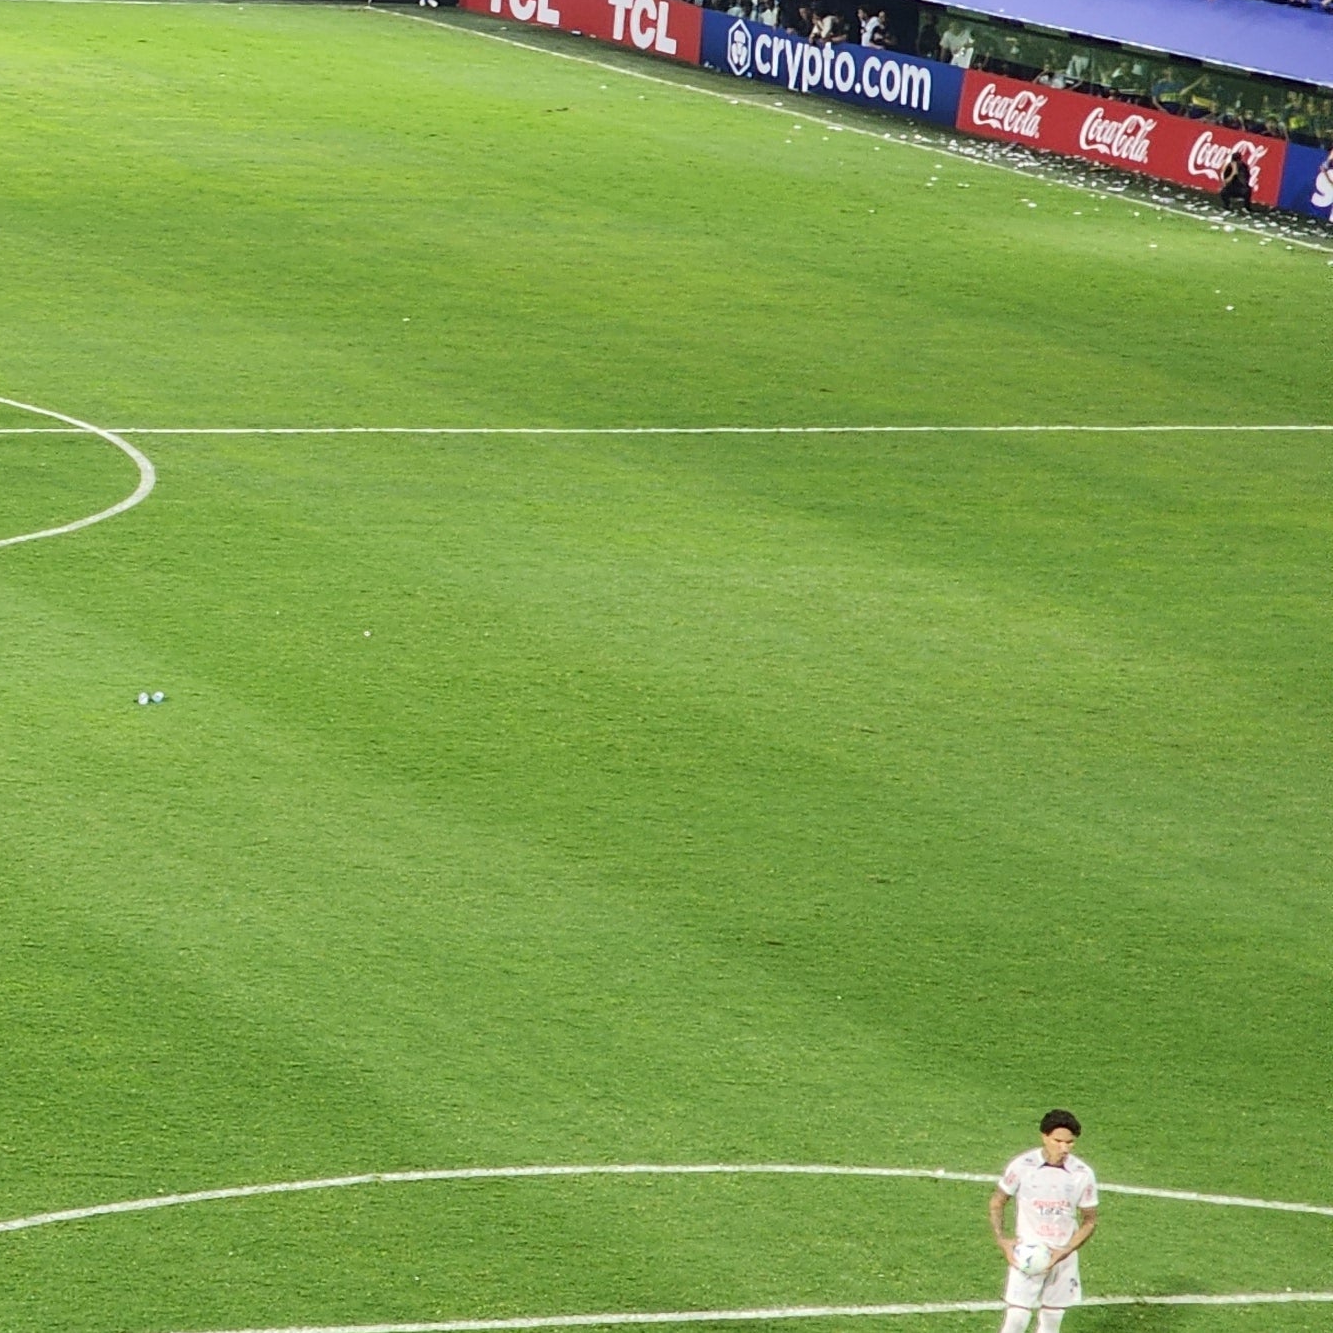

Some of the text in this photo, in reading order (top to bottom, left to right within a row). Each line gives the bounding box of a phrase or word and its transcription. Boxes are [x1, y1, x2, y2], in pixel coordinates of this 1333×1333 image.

[754, 32, 932, 112] crypto.com
[972, 82, 1048, 140] Coca-Cola
[1079, 106, 1156, 164] Coca-Cola
[1187, 130, 1268, 192] Coca-Ca
